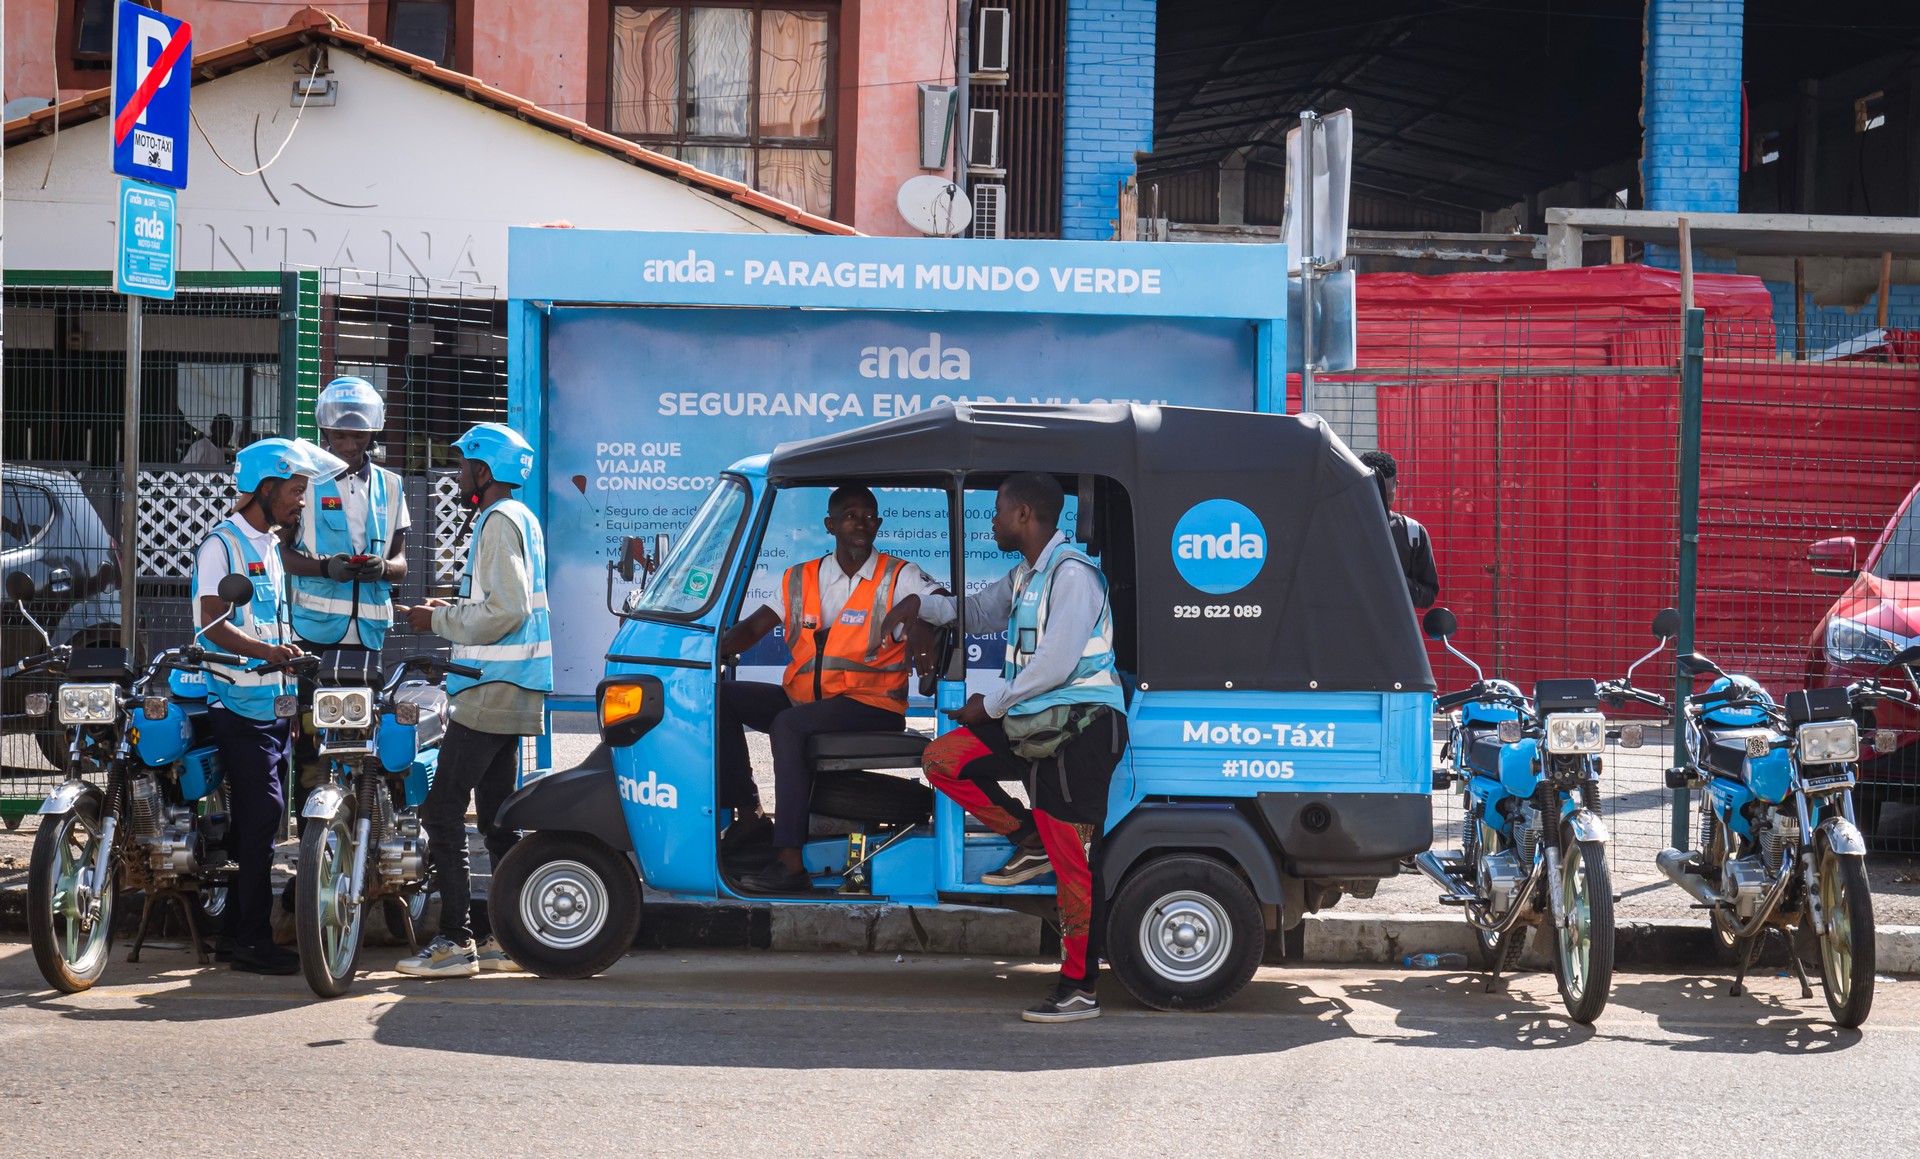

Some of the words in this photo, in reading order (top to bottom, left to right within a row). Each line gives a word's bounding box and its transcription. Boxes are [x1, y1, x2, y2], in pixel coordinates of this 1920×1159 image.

[135, 133, 172, 152] MOTO-TÁXI
[134, 210, 164, 240] anda
[643, 249, 715, 283] anda
[744, 260, 905, 289] PARAGEM
[915, 264, 1040, 292] MUNDO
[1049, 267, 1161, 294] VERDE
[858, 332, 971, 380] anda
[658, 392, 864, 422] SEGURANÇA
[873, 394, 921, 417] EM
[596, 442, 636, 457] POR
[641, 442, 682, 458] QUE
[596, 459, 667, 474] VIAJAR
[596, 476, 715, 491] CONNOSCO?
[606, 506, 649, 518] Seguro
[652, 506, 668, 516] de
[883, 507, 898, 518] de
[902, 508, 931, 518] bens
[893, 528, 937, 540] rápidas
[940, 531, 948, 539] e
[1178, 522, 1264, 560] anda
[964, 550, 999, 561] empo
[1173, 605, 1201, 618] 929
[1204, 605, 1231, 618] 622
[1233, 605, 1262, 618] 089
[1183, 720, 1336, 748] Moto-Táxi
[1222, 759, 1295, 779] #1005
[618, 770, 678, 809] anda
